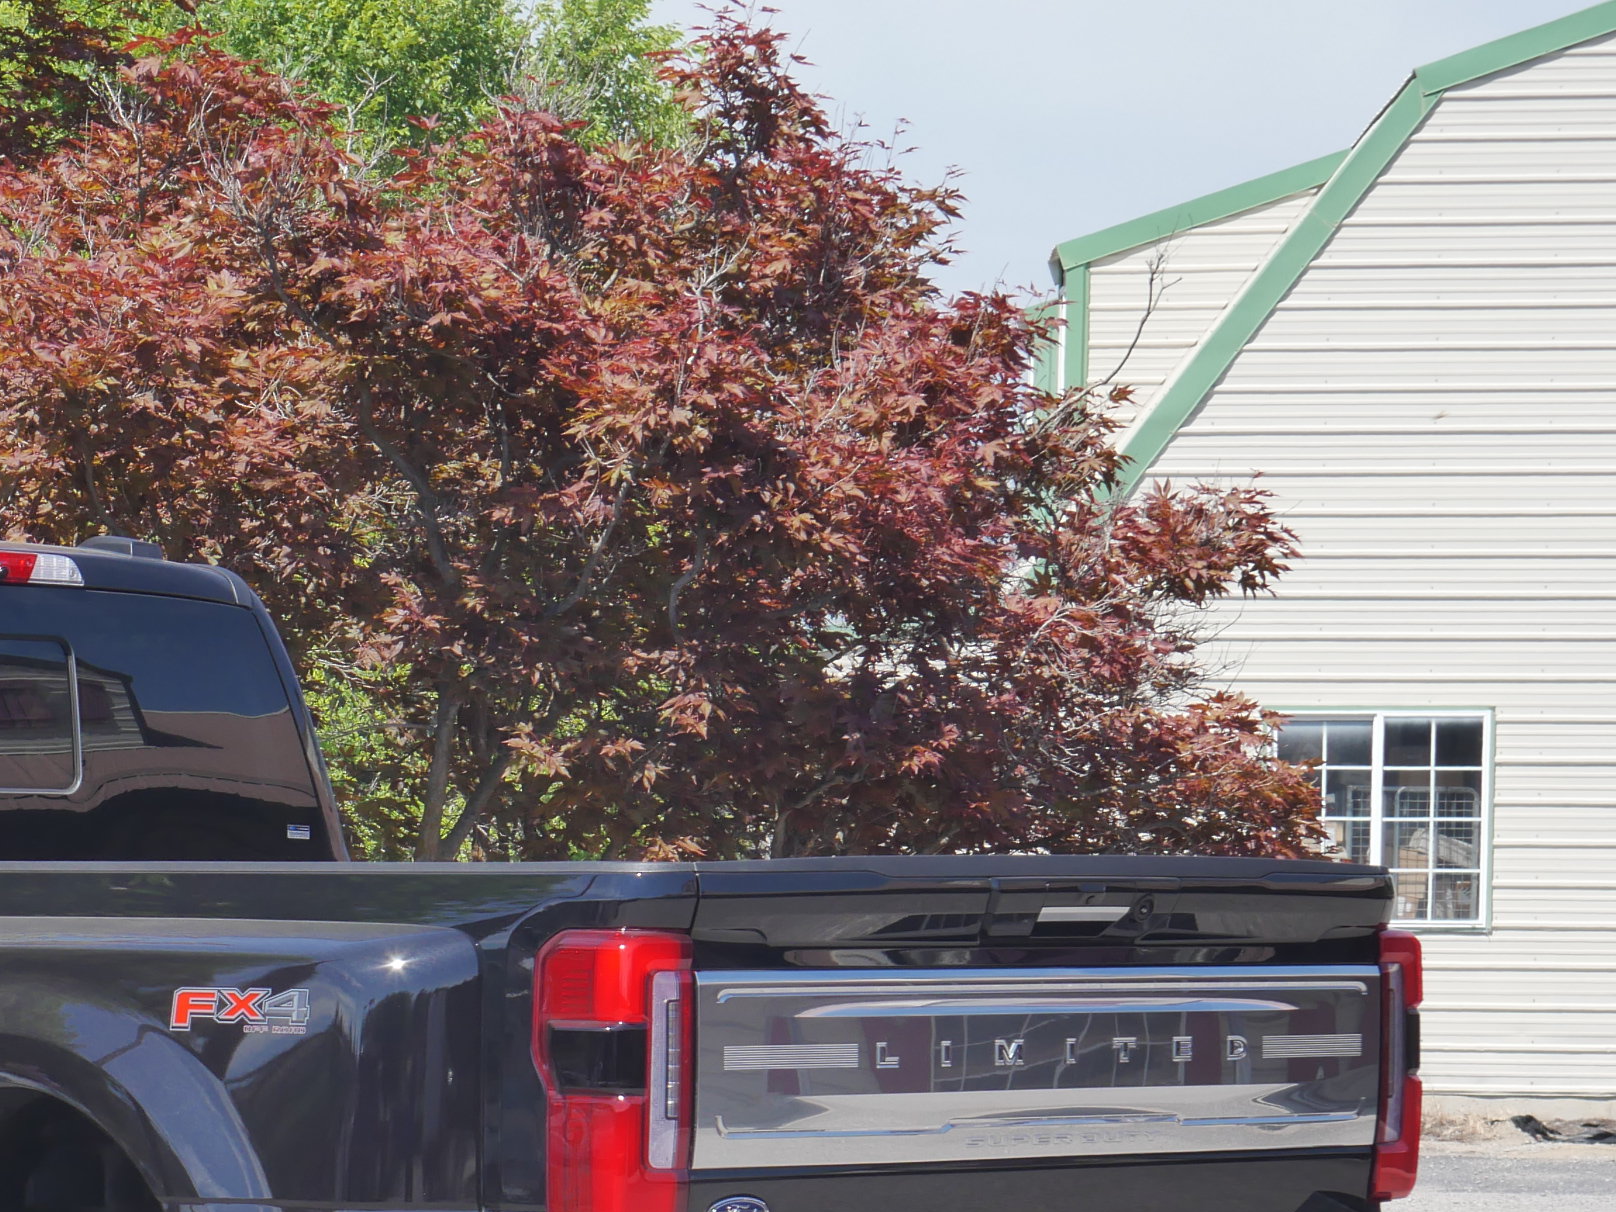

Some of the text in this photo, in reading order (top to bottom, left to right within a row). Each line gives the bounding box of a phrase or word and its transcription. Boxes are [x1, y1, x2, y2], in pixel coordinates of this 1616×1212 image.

[170, 986, 310, 1031] FX4
[875, 1034, 1248, 1069] LIMITED
[965, 1129, 1161, 1149] SUPER DUTY
